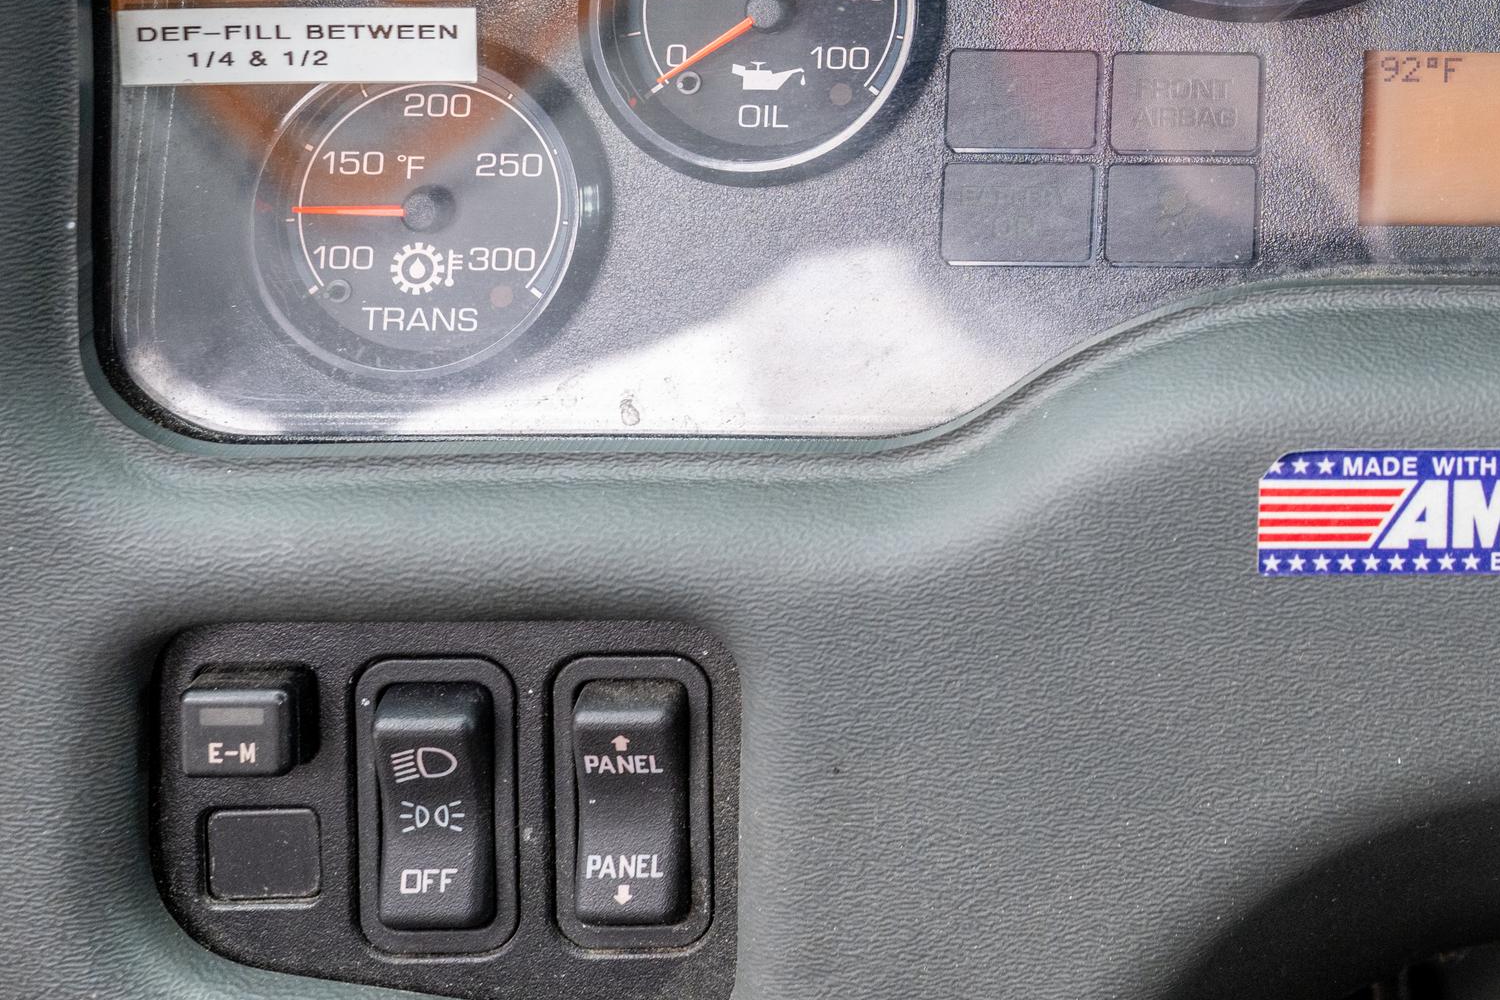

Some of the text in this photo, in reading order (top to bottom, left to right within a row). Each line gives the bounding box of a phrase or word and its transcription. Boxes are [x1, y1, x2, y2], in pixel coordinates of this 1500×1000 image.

[137, 23, 459, 42] DEF-FILL BETWEEN
[188, 50, 329, 67] 1/4 & 1/2
[666, 44, 688, 68] 0
[810, 47, 870, 70] 100
[1381, 57, 1463, 83] 92°F
[1136, 78, 1232, 100] FRONT
[404, 93, 472, 118] 200
[738, 105, 788, 128] OIL
[1131, 106, 1237, 128] AIRBAG
[322, 151, 385, 175] 150
[475, 153, 543, 177] 250
[313, 245, 374, 270] 100
[467, 248, 536, 272] 300
[361, 307, 479, 332] TRANS
[1342, 457, 1418, 477] MADE
[1433, 456, 1497, 477] WITH
[208, 742, 257, 764] E-M
[584, 754, 664, 775] PANEL
[585, 854, 664, 880] PANEL
[400, 868, 458, 895] OFF
